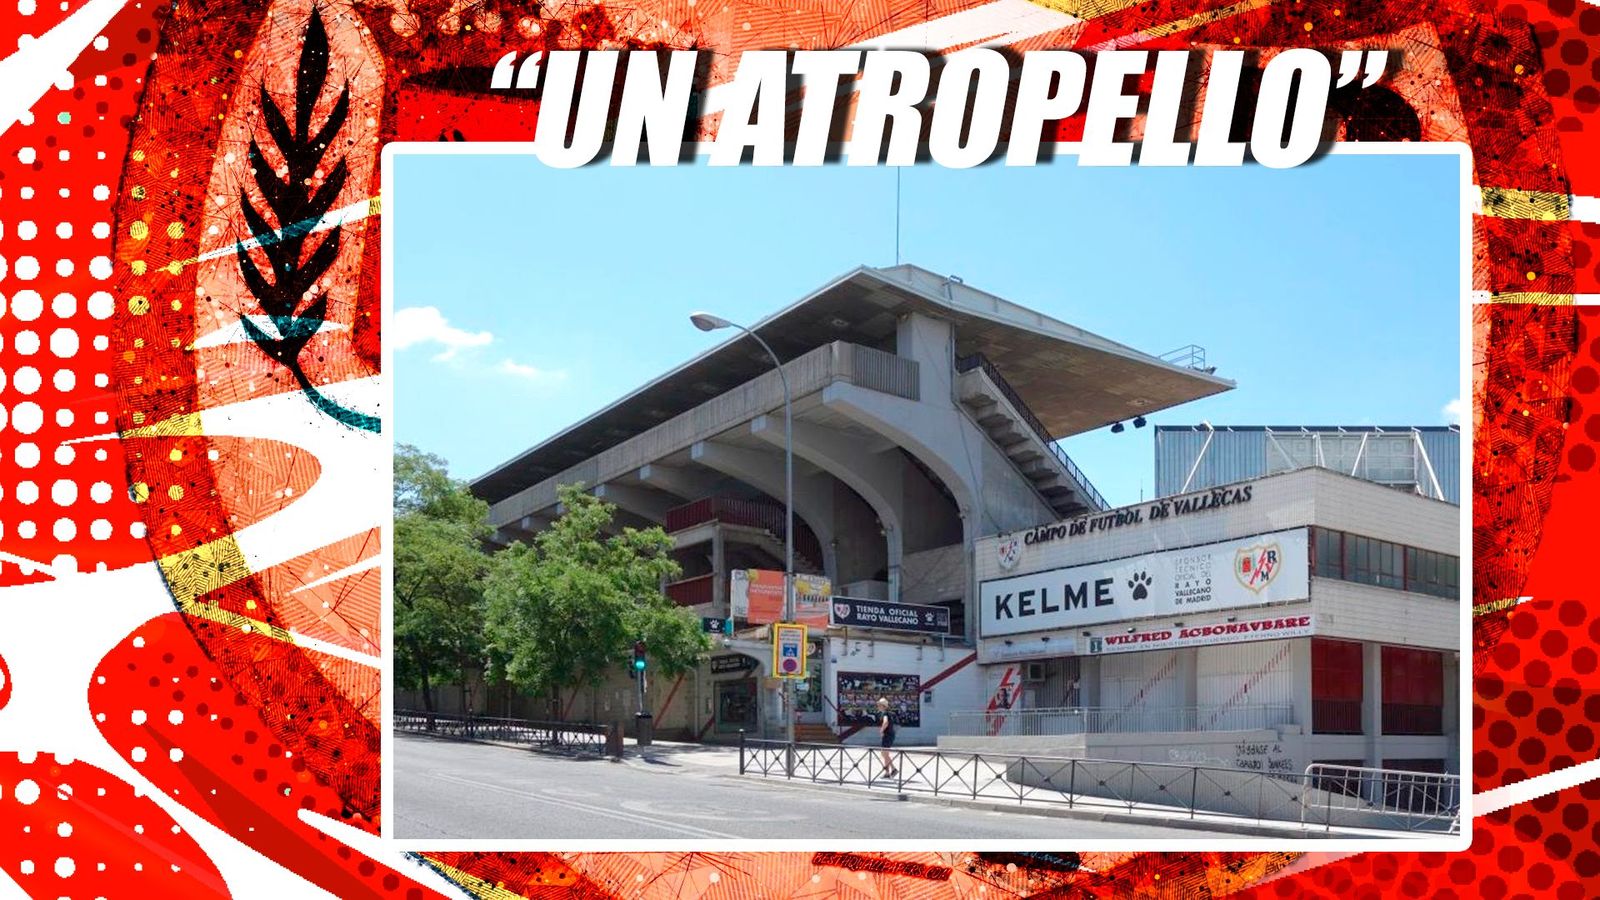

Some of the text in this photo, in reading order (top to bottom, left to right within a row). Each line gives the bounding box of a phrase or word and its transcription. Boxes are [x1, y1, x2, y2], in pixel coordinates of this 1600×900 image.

[1024, 486, 1252, 545] CAMPO DE FUTBOL DE VALLECAS
[1174, 586, 1212, 597] VALLECANO
[995, 578, 1114, 620] KELME
[1186, 594, 1212, 604] MADRID
[856, 604, 919, 618] TIENDA OFICIAL
[857, 613, 919, 625] RAYO VALLECANO
[1105, 616, 1310, 645] WILFRED AGBONAVBARE
[1273, 744, 1282, 753] AL
